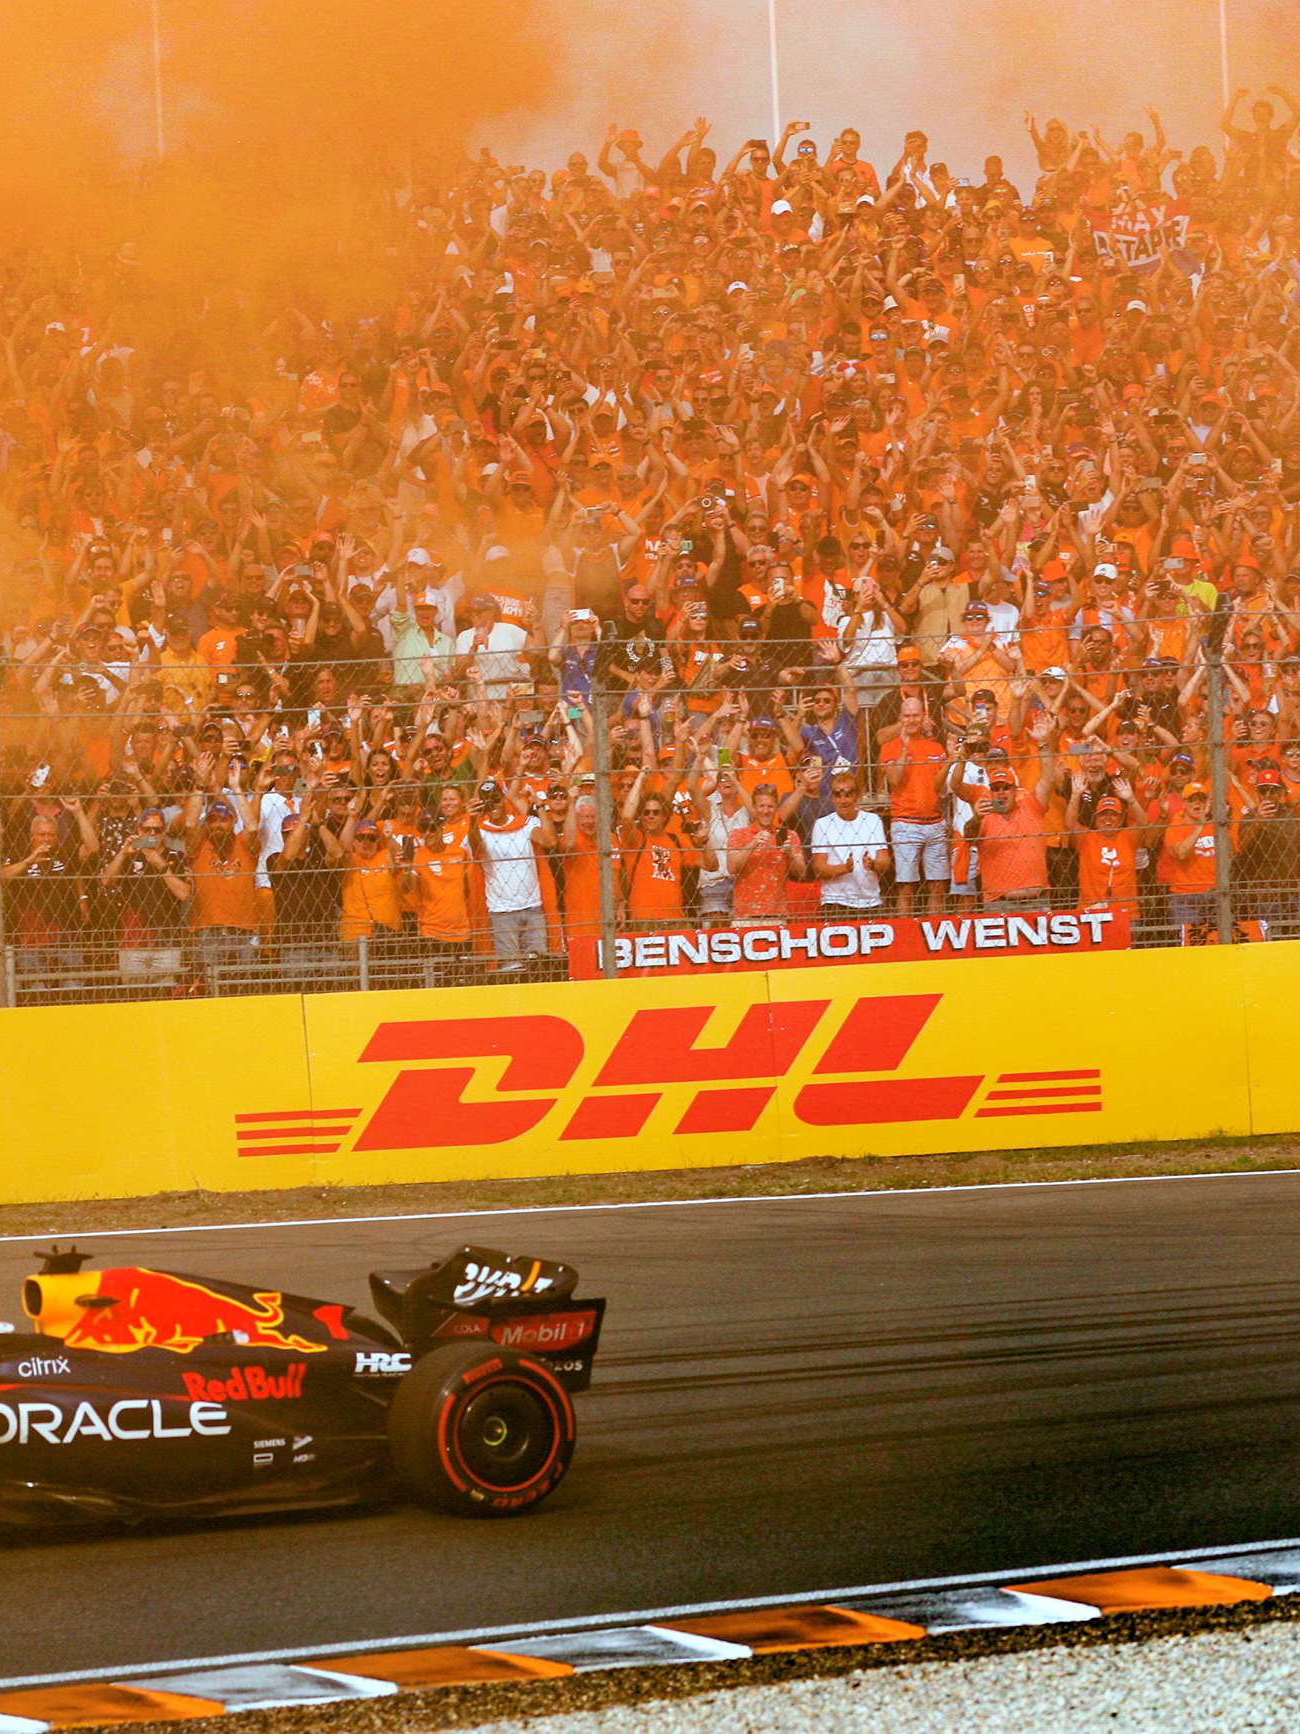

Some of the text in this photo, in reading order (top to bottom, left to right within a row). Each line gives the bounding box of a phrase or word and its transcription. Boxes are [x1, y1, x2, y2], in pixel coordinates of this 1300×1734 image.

[597, 912, 1114, 969] BENSCHOP WENST
[351, 992, 987, 1153] DHL
[501, 1323, 567, 1346] Mobil
[18, 1356, 71, 1378] citrix
[354, 1352, 412, 1373] HRC
[253, 1438, 286, 1449] SIEMENS
